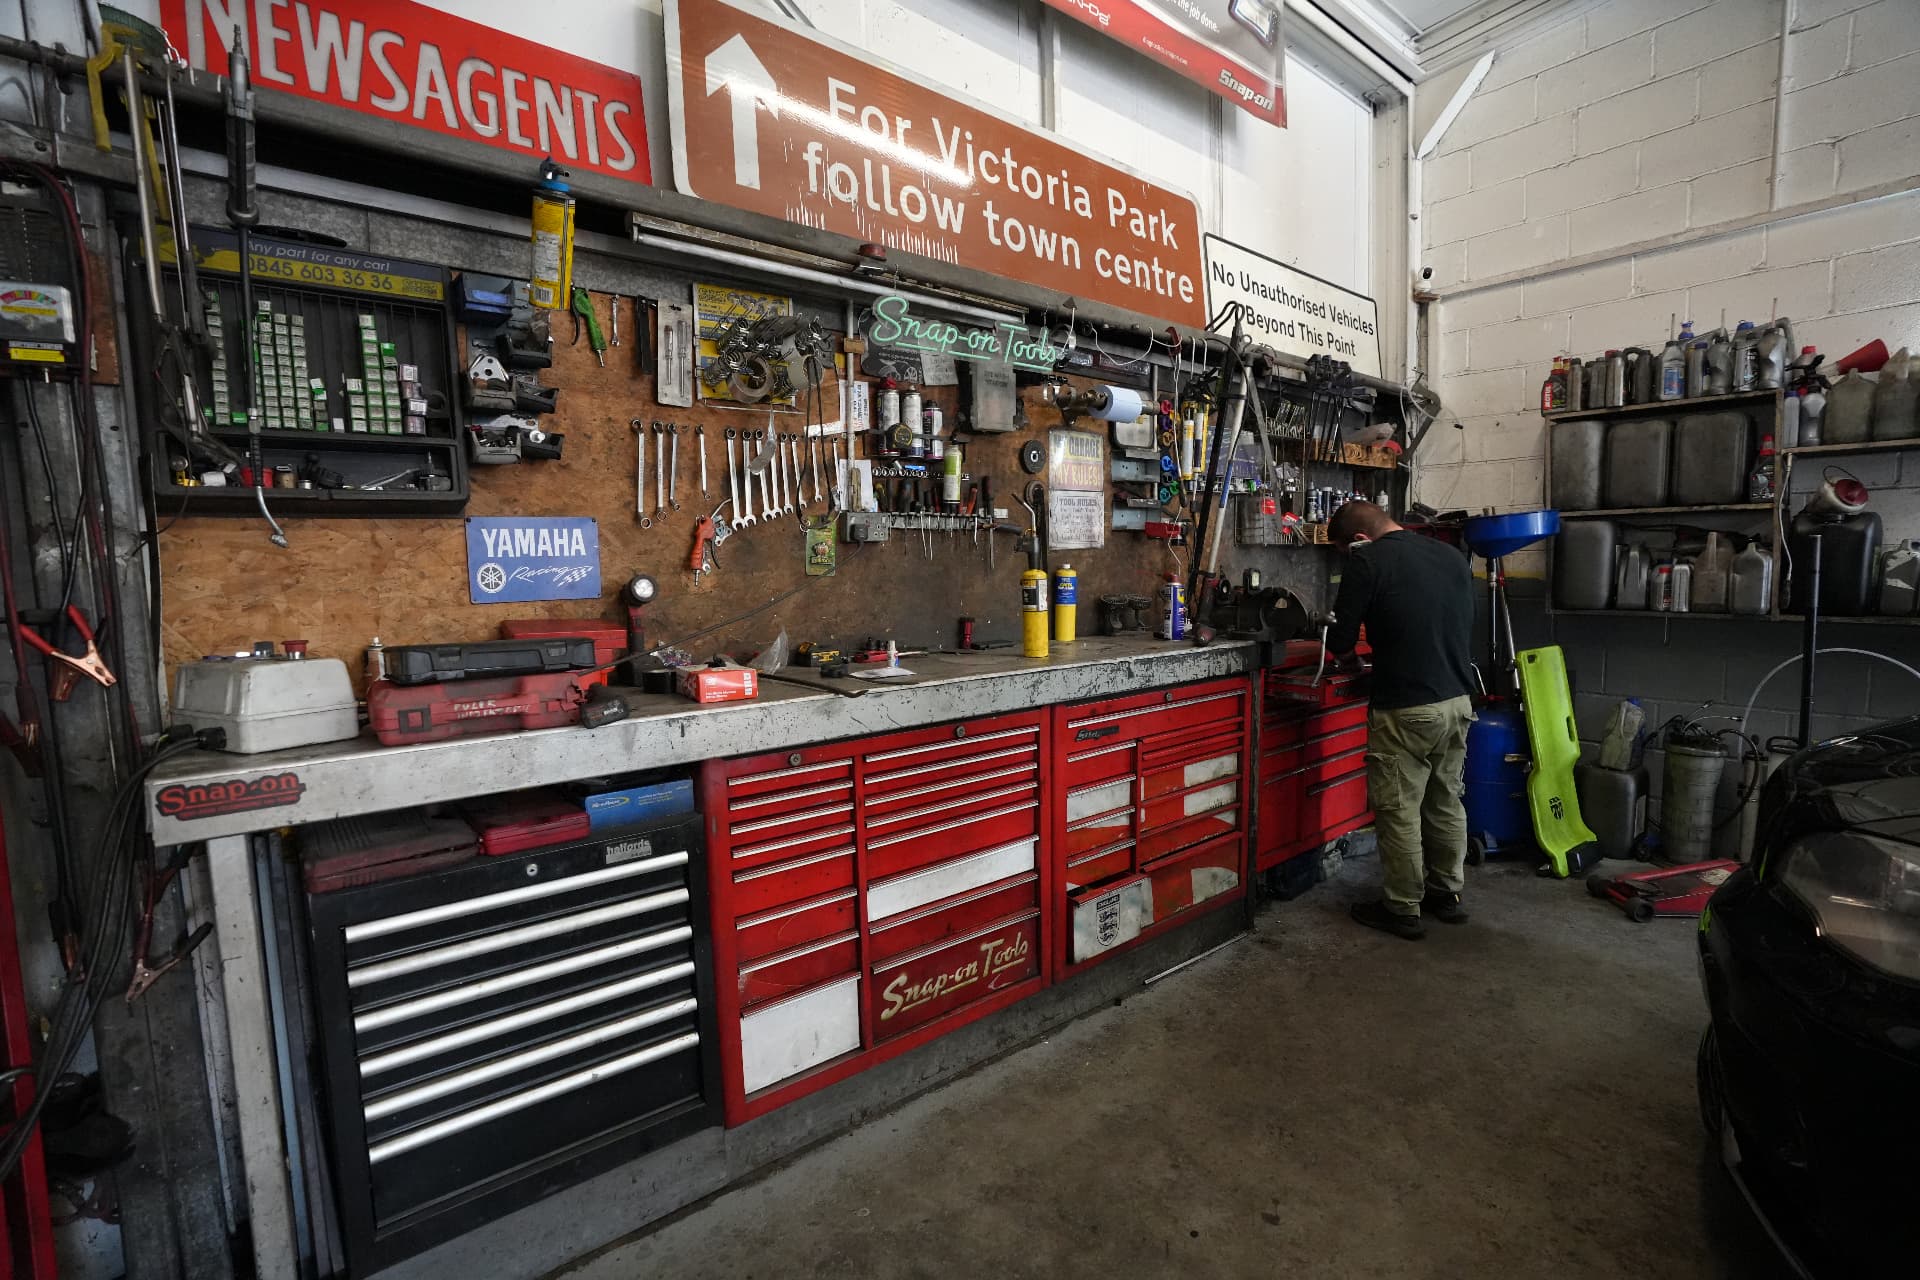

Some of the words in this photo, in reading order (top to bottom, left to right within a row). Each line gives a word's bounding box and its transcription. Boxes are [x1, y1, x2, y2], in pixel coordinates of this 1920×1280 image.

[1189, 2, 1200, 20] job
[184, 0, 638, 173] NEWSAGENTS
[1218, 68, 1273, 112] Snap-on
[827, 76, 912, 147] For
[931, 116, 1093, 219] Victoria
[1107, 187, 1180, 250] Park
[802, 142, 966, 235] follow
[983, 200, 1082, 270] town
[1095, 246, 1194, 303] centre
[276, 246, 306, 259] part
[311, 251, 330, 263] for
[334, 255, 360, 268] any
[363, 259, 391, 272] car!
[300, 266, 335, 283] 603
[342, 271, 365, 287] 36
[370, 274, 393, 290] 36
[1212, 260, 1235, 287] No
[1240, 270, 1326, 319] Unauthorised
[1328, 303, 1374, 336] Vehicles
[873, 296, 1000, 353] Snap-on
[1000, 322, 1057, 364] Tools
[1246, 304, 1295, 338] Beyond
[1298, 322, 1324, 347] This
[1326, 331, 1356, 356] Point
[1069, 435, 1099, 458] GARAGE
[481, 528, 587, 558] YAMAHA
[508, 565, 572, 583] Racing
[159, 772, 298, 814] Snap-on
[606, 838, 651, 856] halfords
[880, 960, 978, 1021] Snap-on
[980, 931, 1029, 978] Tools
